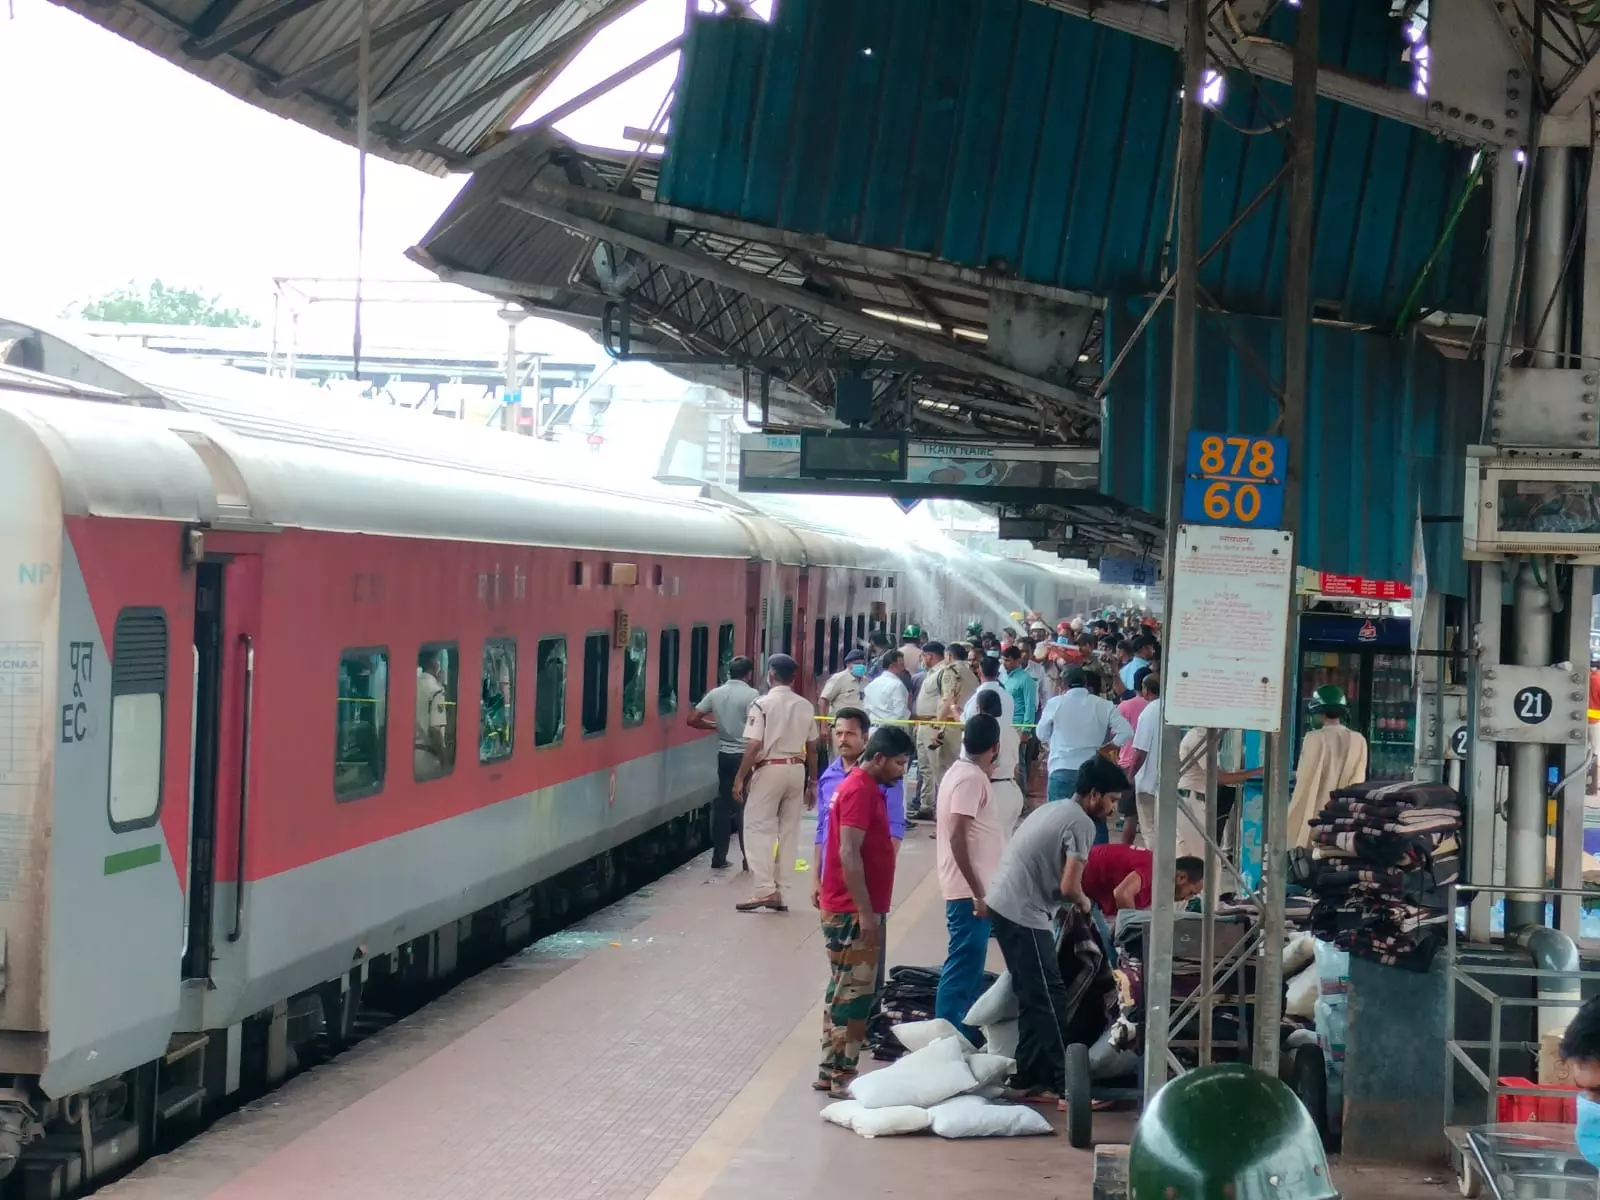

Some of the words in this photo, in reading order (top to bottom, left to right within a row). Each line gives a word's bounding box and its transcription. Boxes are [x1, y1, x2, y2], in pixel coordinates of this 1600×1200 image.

[766, 437, 793, 448] TRAIN
[923, 443, 956, 456] TRAIN
[960, 446, 995, 457] NAME
[1199, 436, 1275, 478] 878
[1203, 482, 1261, 522] 60
[0, 659, 40, 670] CNAA
[1520, 692, 1543, 718] 21
[61, 702, 88, 744] EC
[1457, 731, 1468, 754] 2
